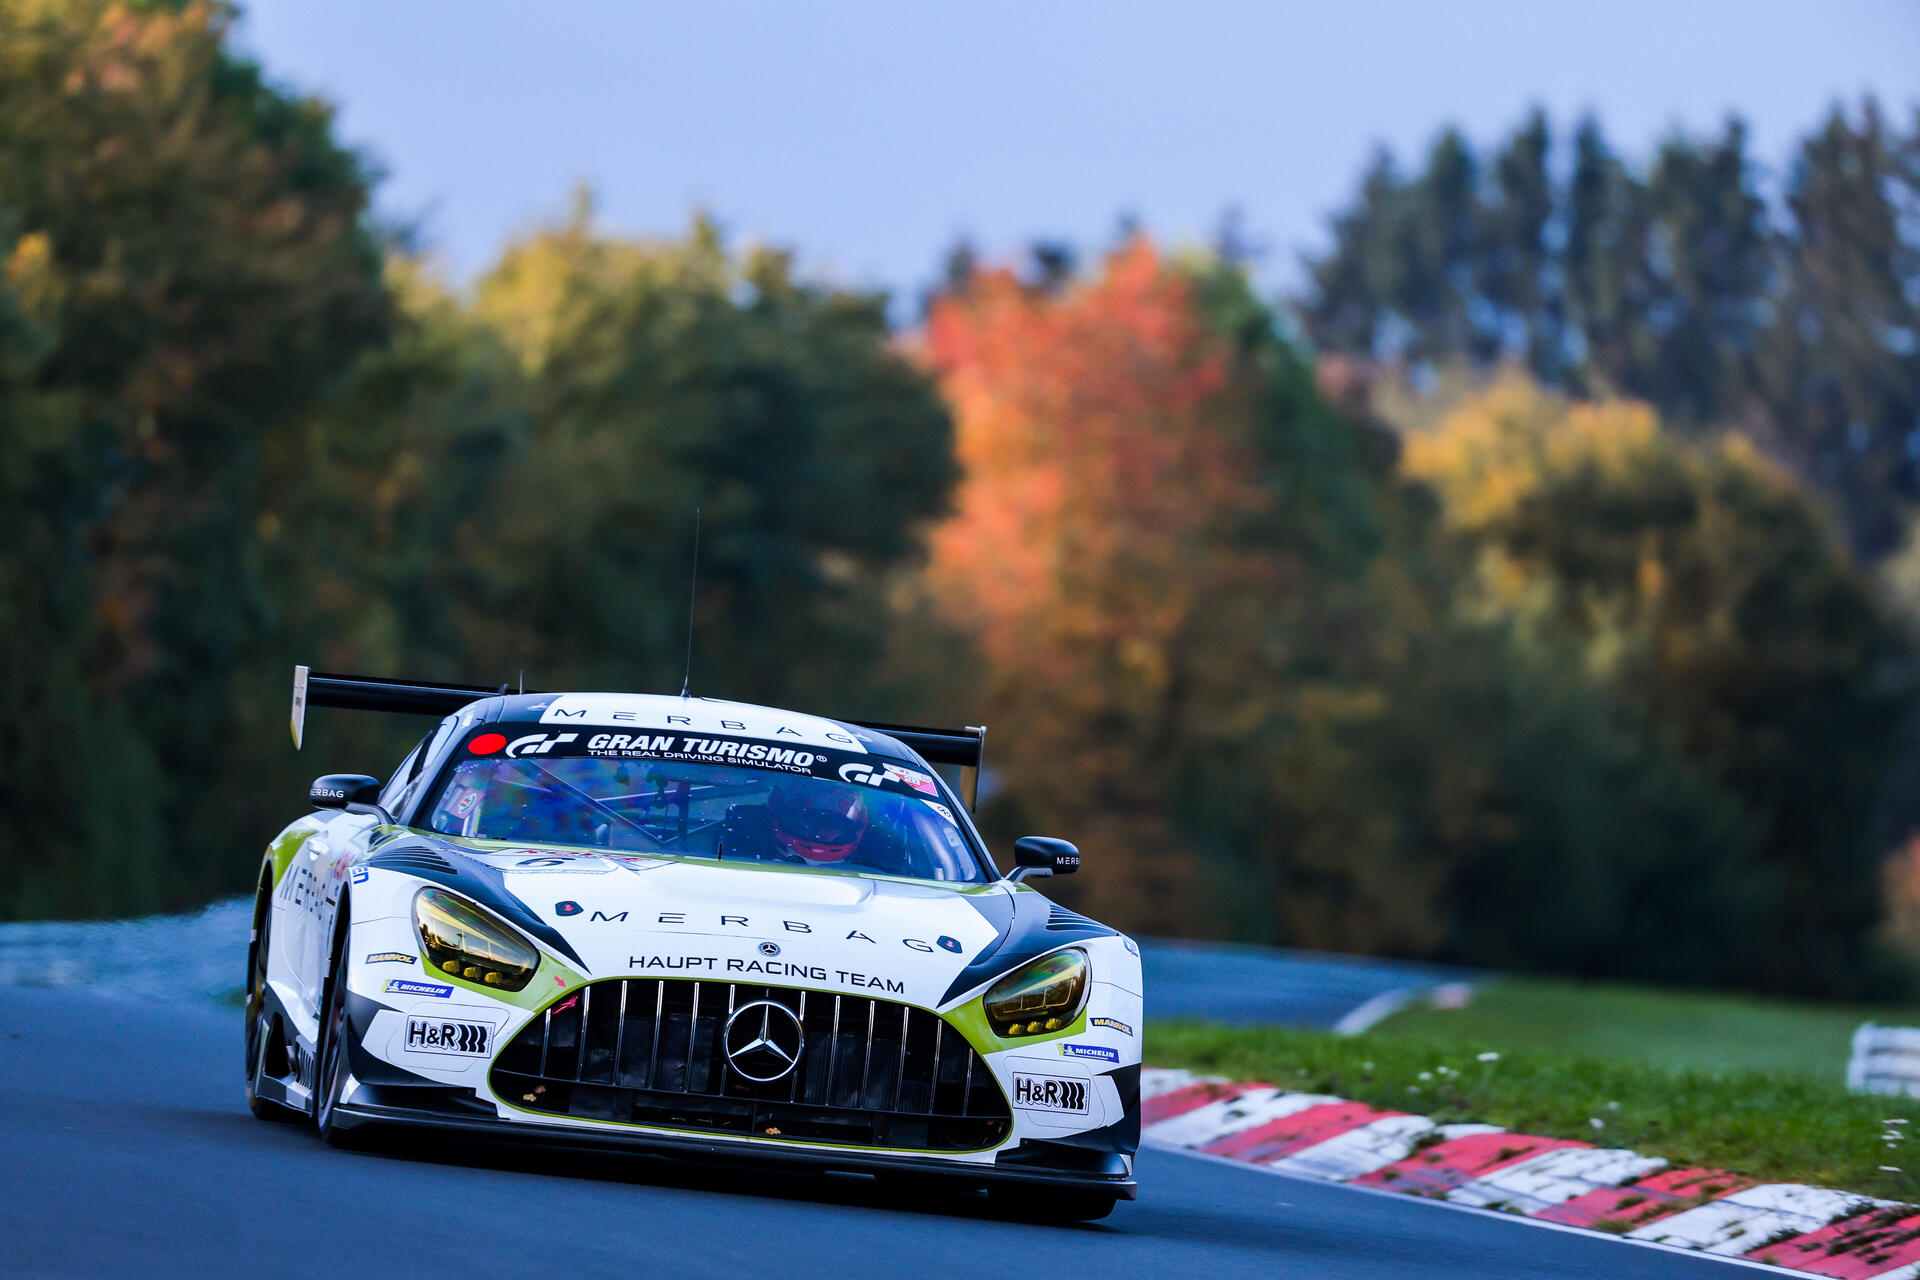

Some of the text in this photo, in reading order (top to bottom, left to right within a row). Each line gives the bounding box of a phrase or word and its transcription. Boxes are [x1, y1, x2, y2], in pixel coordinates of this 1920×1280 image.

[554, 709, 853, 744] MERBAG
[587, 733, 676, 751] GRAN
[588, 749, 812, 775] THE REAL DRIVING SIMULATOR
[590, 910, 935, 953] MERBAG
[400, 983, 448, 995] MICHELIN
[629, 955, 905, 995] HAUPT RACING TEAM
[408, 1020, 459, 1050] H&R
[1075, 1047, 1115, 1058] MICHELIN
[1015, 1077, 1061, 1107] H&R
